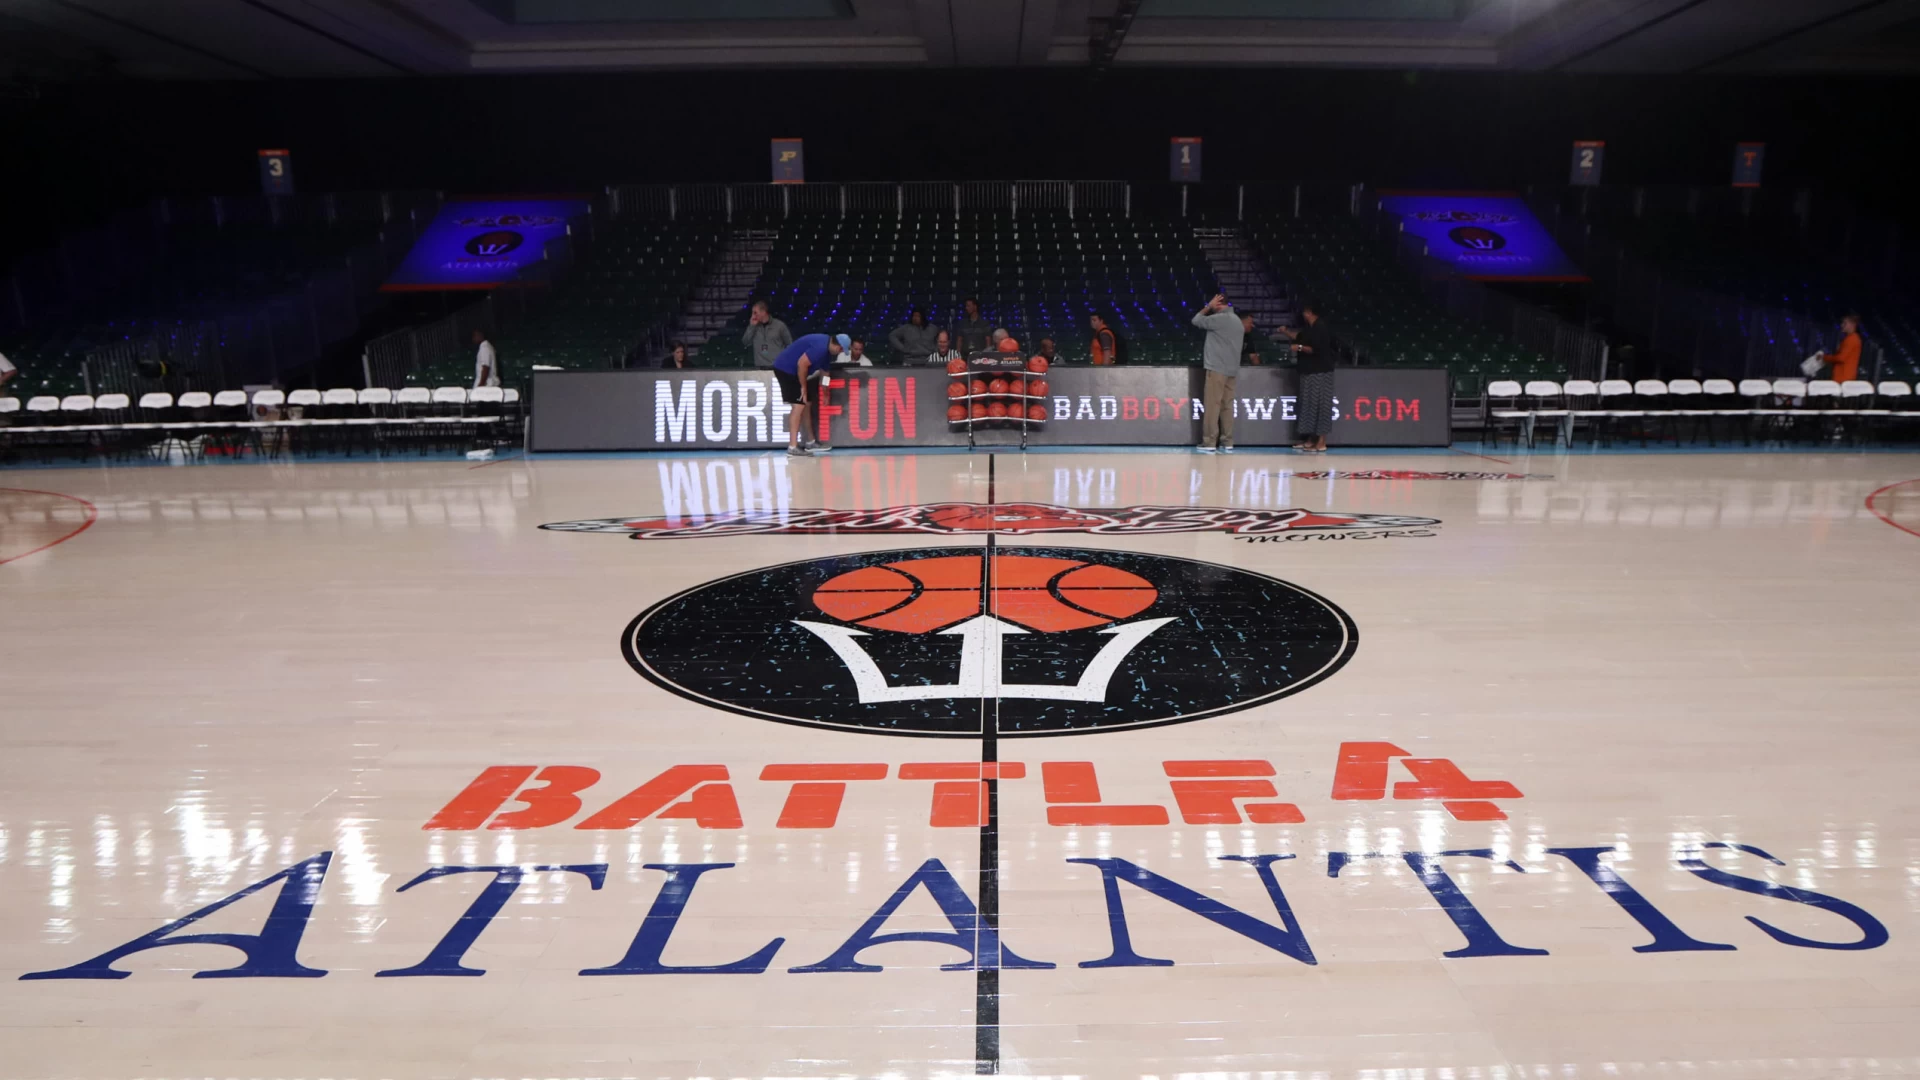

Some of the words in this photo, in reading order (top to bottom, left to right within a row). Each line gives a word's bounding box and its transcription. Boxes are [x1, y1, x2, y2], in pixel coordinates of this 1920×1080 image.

[779, 151, 797, 163] P
[1181, 145, 1190, 164] 1
[1580, 148, 1594, 168] 2
[268, 158, 283, 177] 3
[655, 380, 802, 442] MORE
[818, 377, 916, 441] FUN
[422, 760, 1304, 829] BATTLE
[1331, 741, 1524, 821] 4
[18, 841, 1889, 979] ATLANTIS
